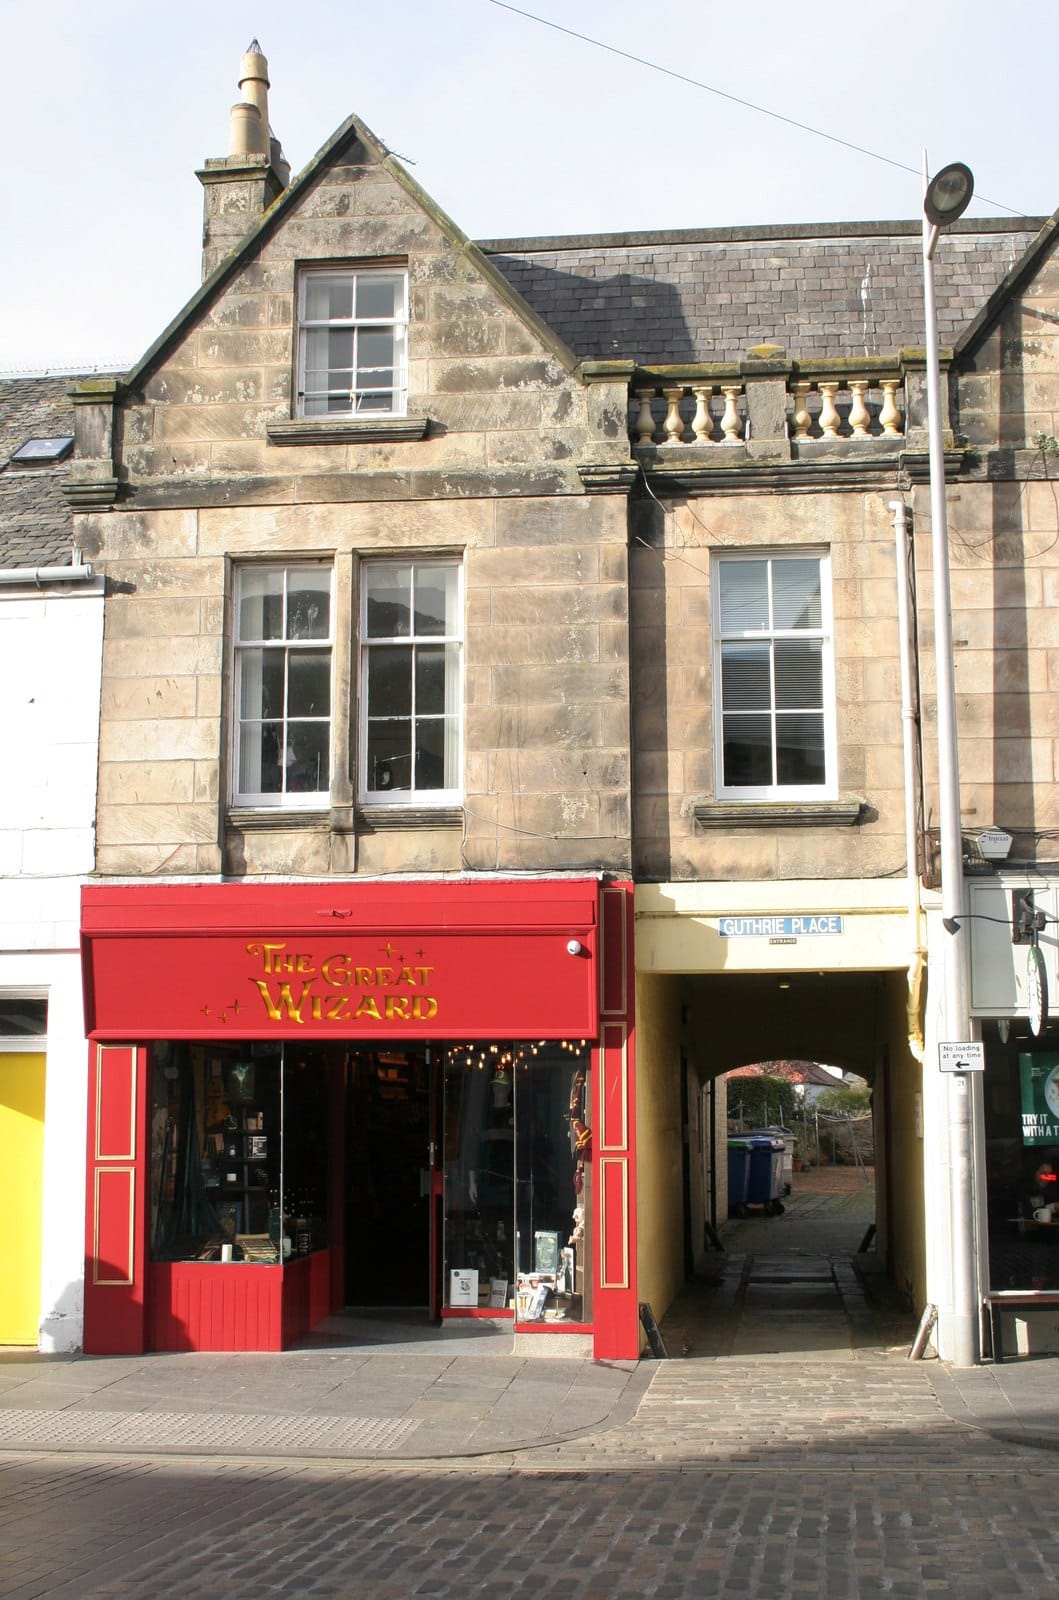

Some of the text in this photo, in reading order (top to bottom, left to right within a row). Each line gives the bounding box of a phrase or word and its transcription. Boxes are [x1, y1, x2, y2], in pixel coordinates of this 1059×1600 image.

[723, 917, 837, 935] GUTHRIE PLACE
[246, 942, 435, 987] THE GREAT
[248, 977, 438, 1024] WIZARD
[955, 1044, 980, 1052] loading
[1021, 1113, 1048, 1125] TRY IT
[1022, 1125, 1045, 1137] WITH
[1045, 1125, 1053, 1137] A
